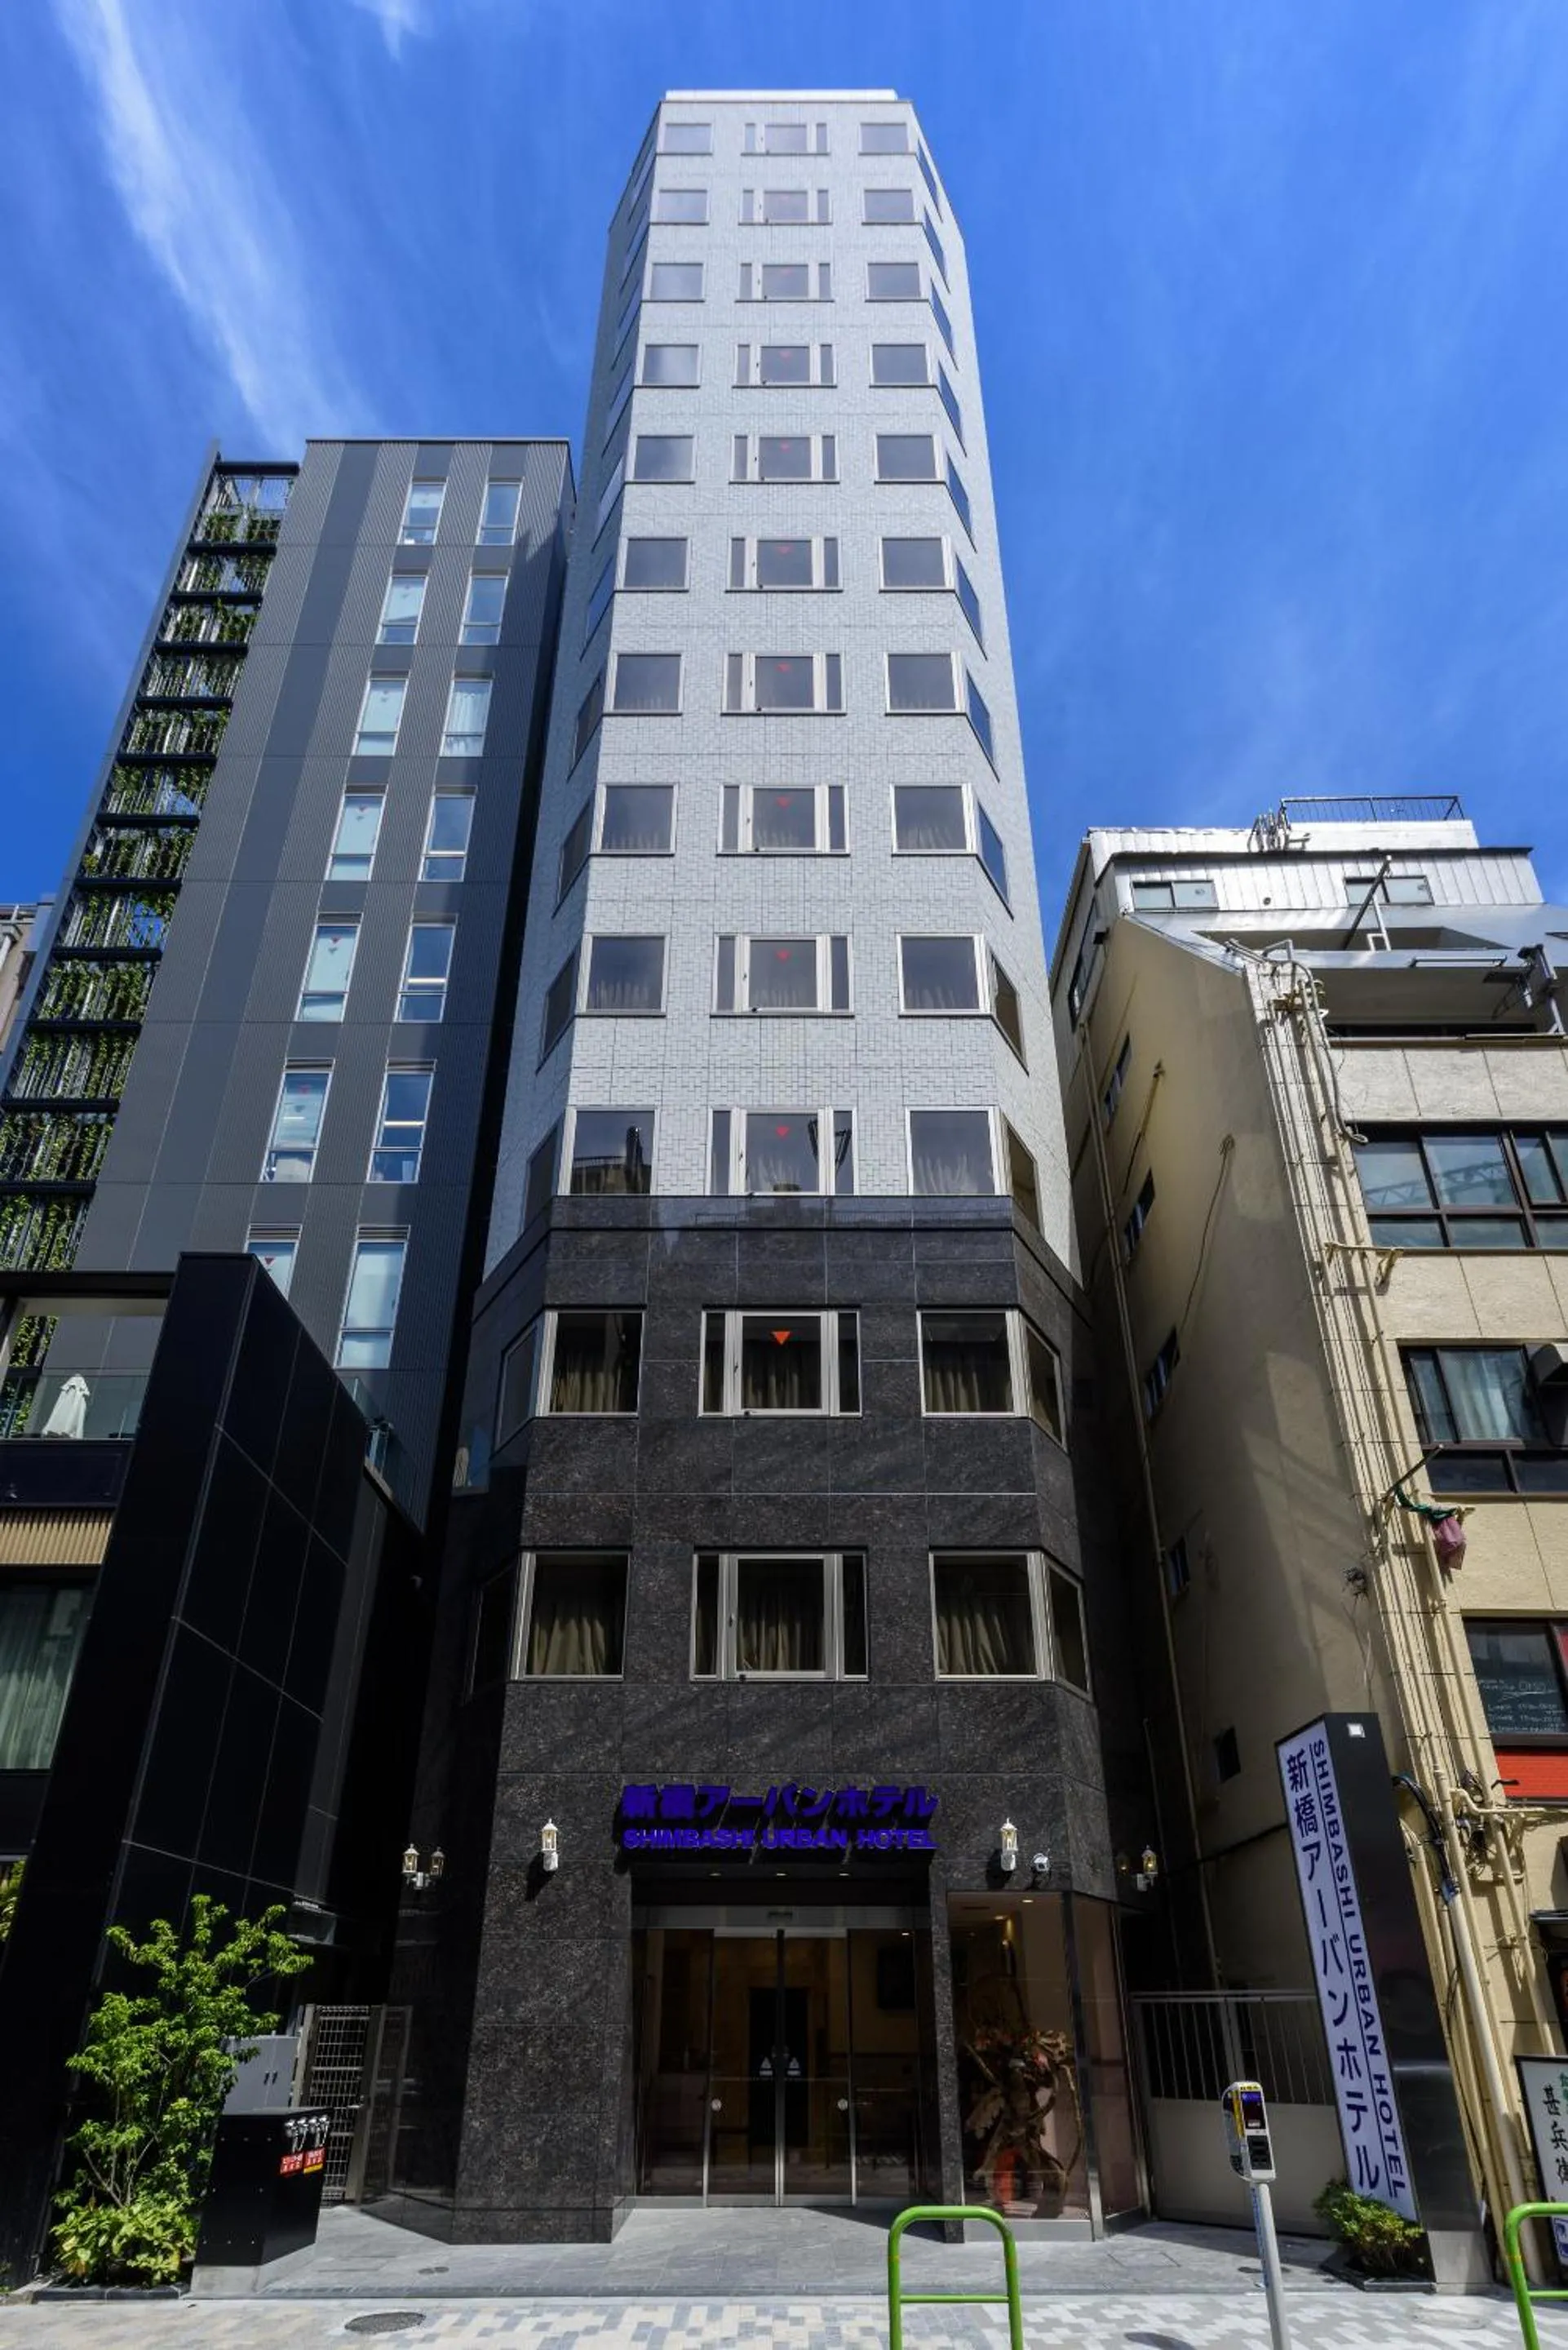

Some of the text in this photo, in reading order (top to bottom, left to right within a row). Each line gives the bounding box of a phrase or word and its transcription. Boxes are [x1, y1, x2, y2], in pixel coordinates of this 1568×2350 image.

[622, 1828, 939, 1849] SHIMBASHI URBAN HOTEL
[1286, 1747, 1380, 2192] 新橋アーバンホテル
[1313, 1738, 1406, 2198] SHIMBASHI URBAN HOTEL
